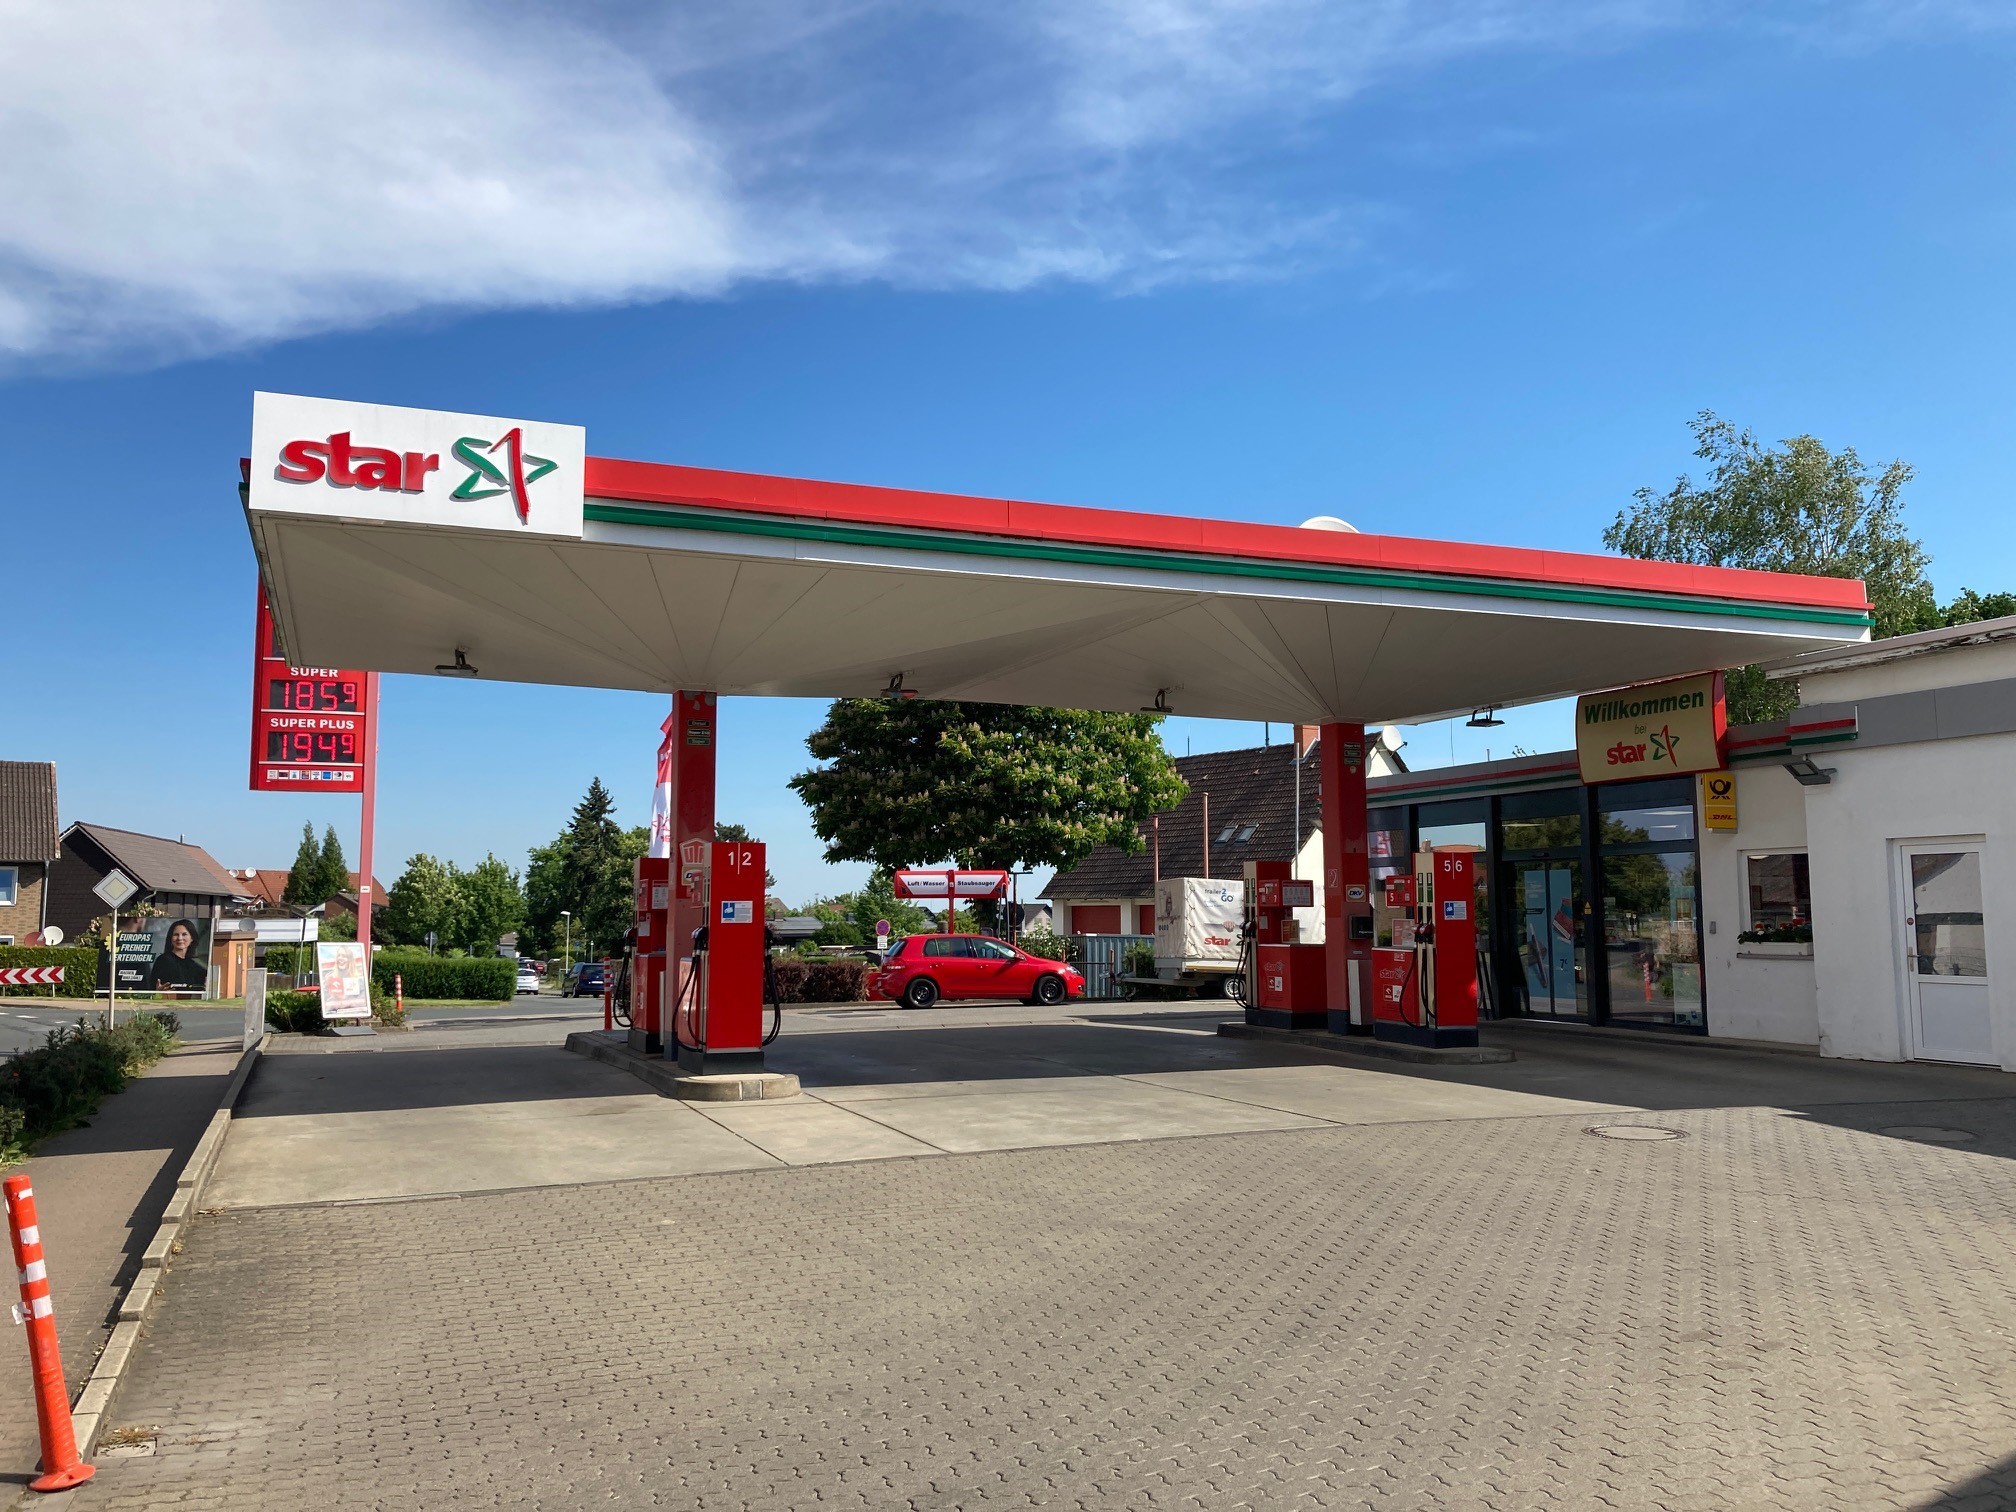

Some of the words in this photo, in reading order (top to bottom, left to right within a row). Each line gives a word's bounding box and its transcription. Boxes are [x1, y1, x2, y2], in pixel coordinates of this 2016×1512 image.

[277, 431, 440, 493] star
[290, 667, 338, 678] SUPER
[1584, 691, 1704, 725] Willkommen
[270, 717, 316, 728] SUPER
[319, 719, 355, 730] PLUS
[1634, 724, 1647, 735] bei
[1606, 740, 1647, 766] star
[728, 851, 735, 866] 1
[741, 851, 752, 866] 2
[1444, 860, 1451, 872] 5
[1455, 860, 1463, 872] 6
[1348, 889, 1363, 897] DKV
[1221, 895, 1234, 903] GO
[119, 934, 151, 942] EUROPAS
[1203, 935, 1232, 946] star
[120, 943, 151, 952] FREIHEIT
[109, 953, 154, 962] ERTEIDIGEN.
